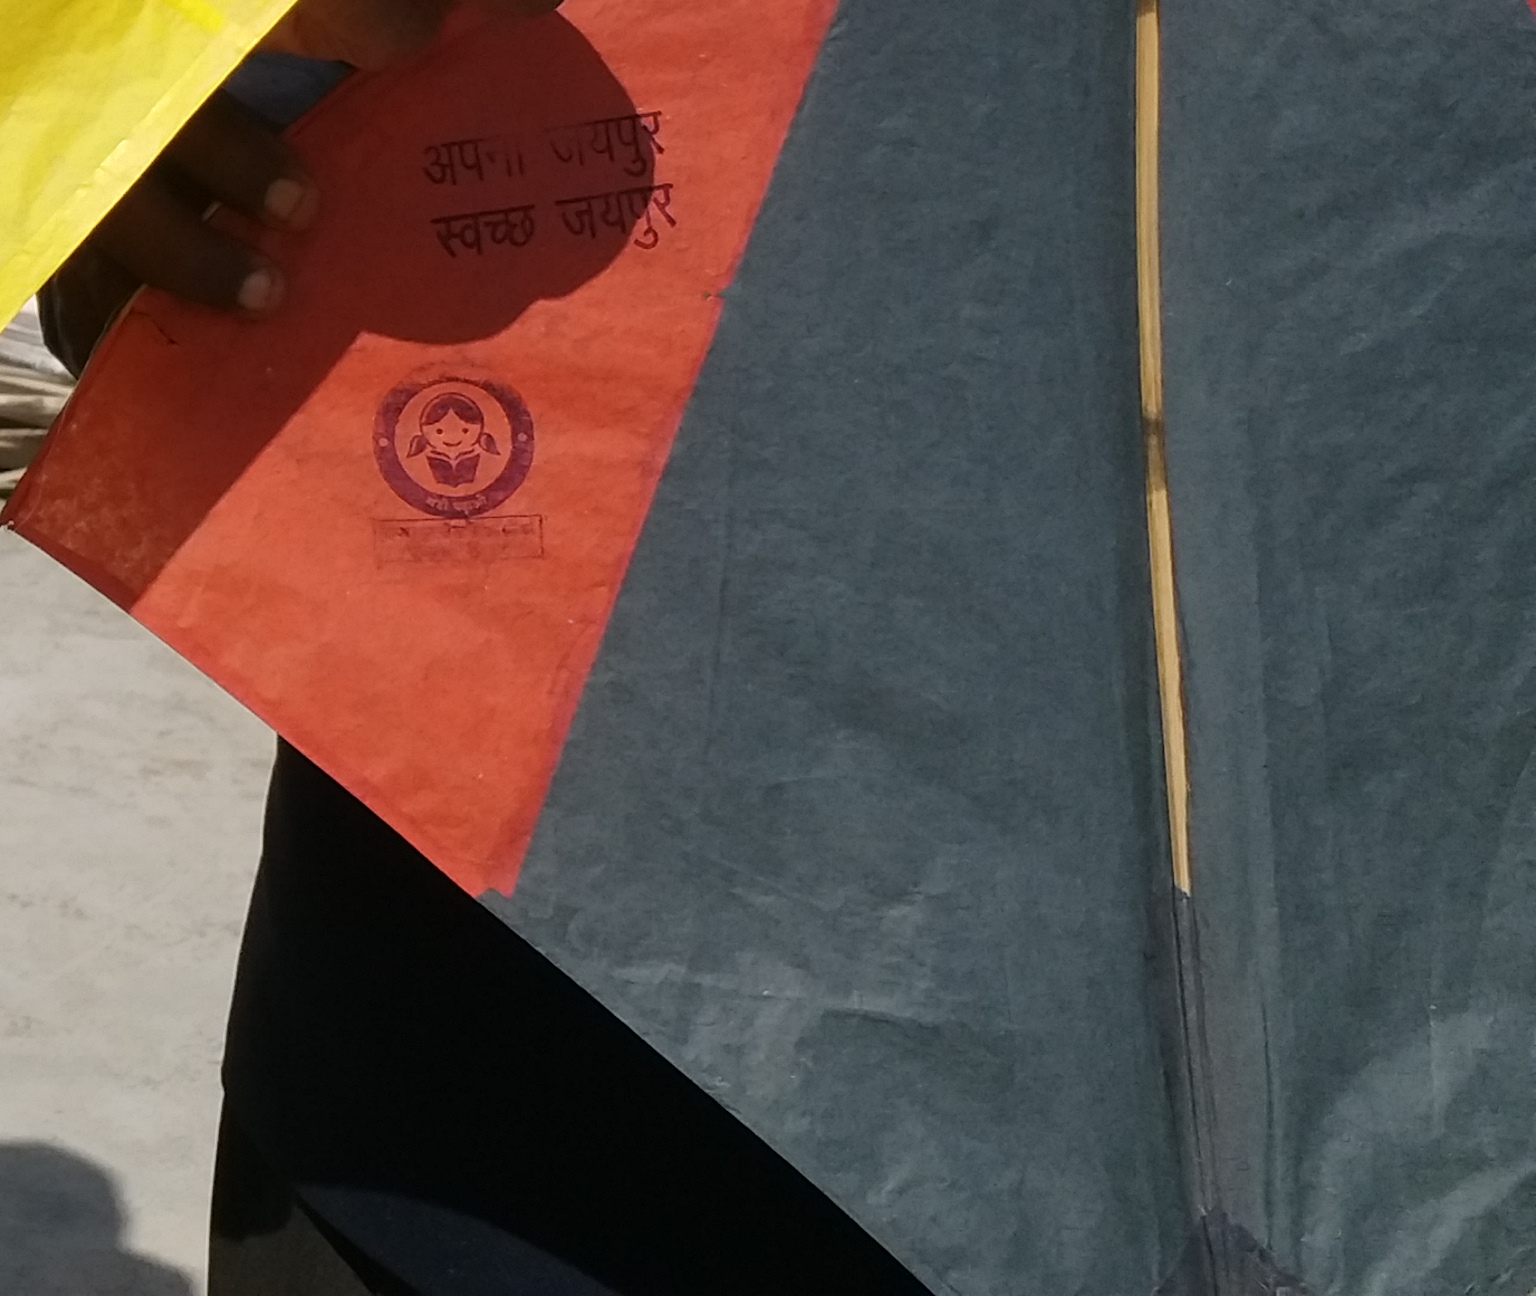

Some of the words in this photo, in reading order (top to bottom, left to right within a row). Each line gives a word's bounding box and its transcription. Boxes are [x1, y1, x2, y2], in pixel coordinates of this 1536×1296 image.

[542, 110, 666, 178] जयपुर
[430, 205, 536, 259] स्वच्छ
[554, 183, 677, 250] जयपुर
